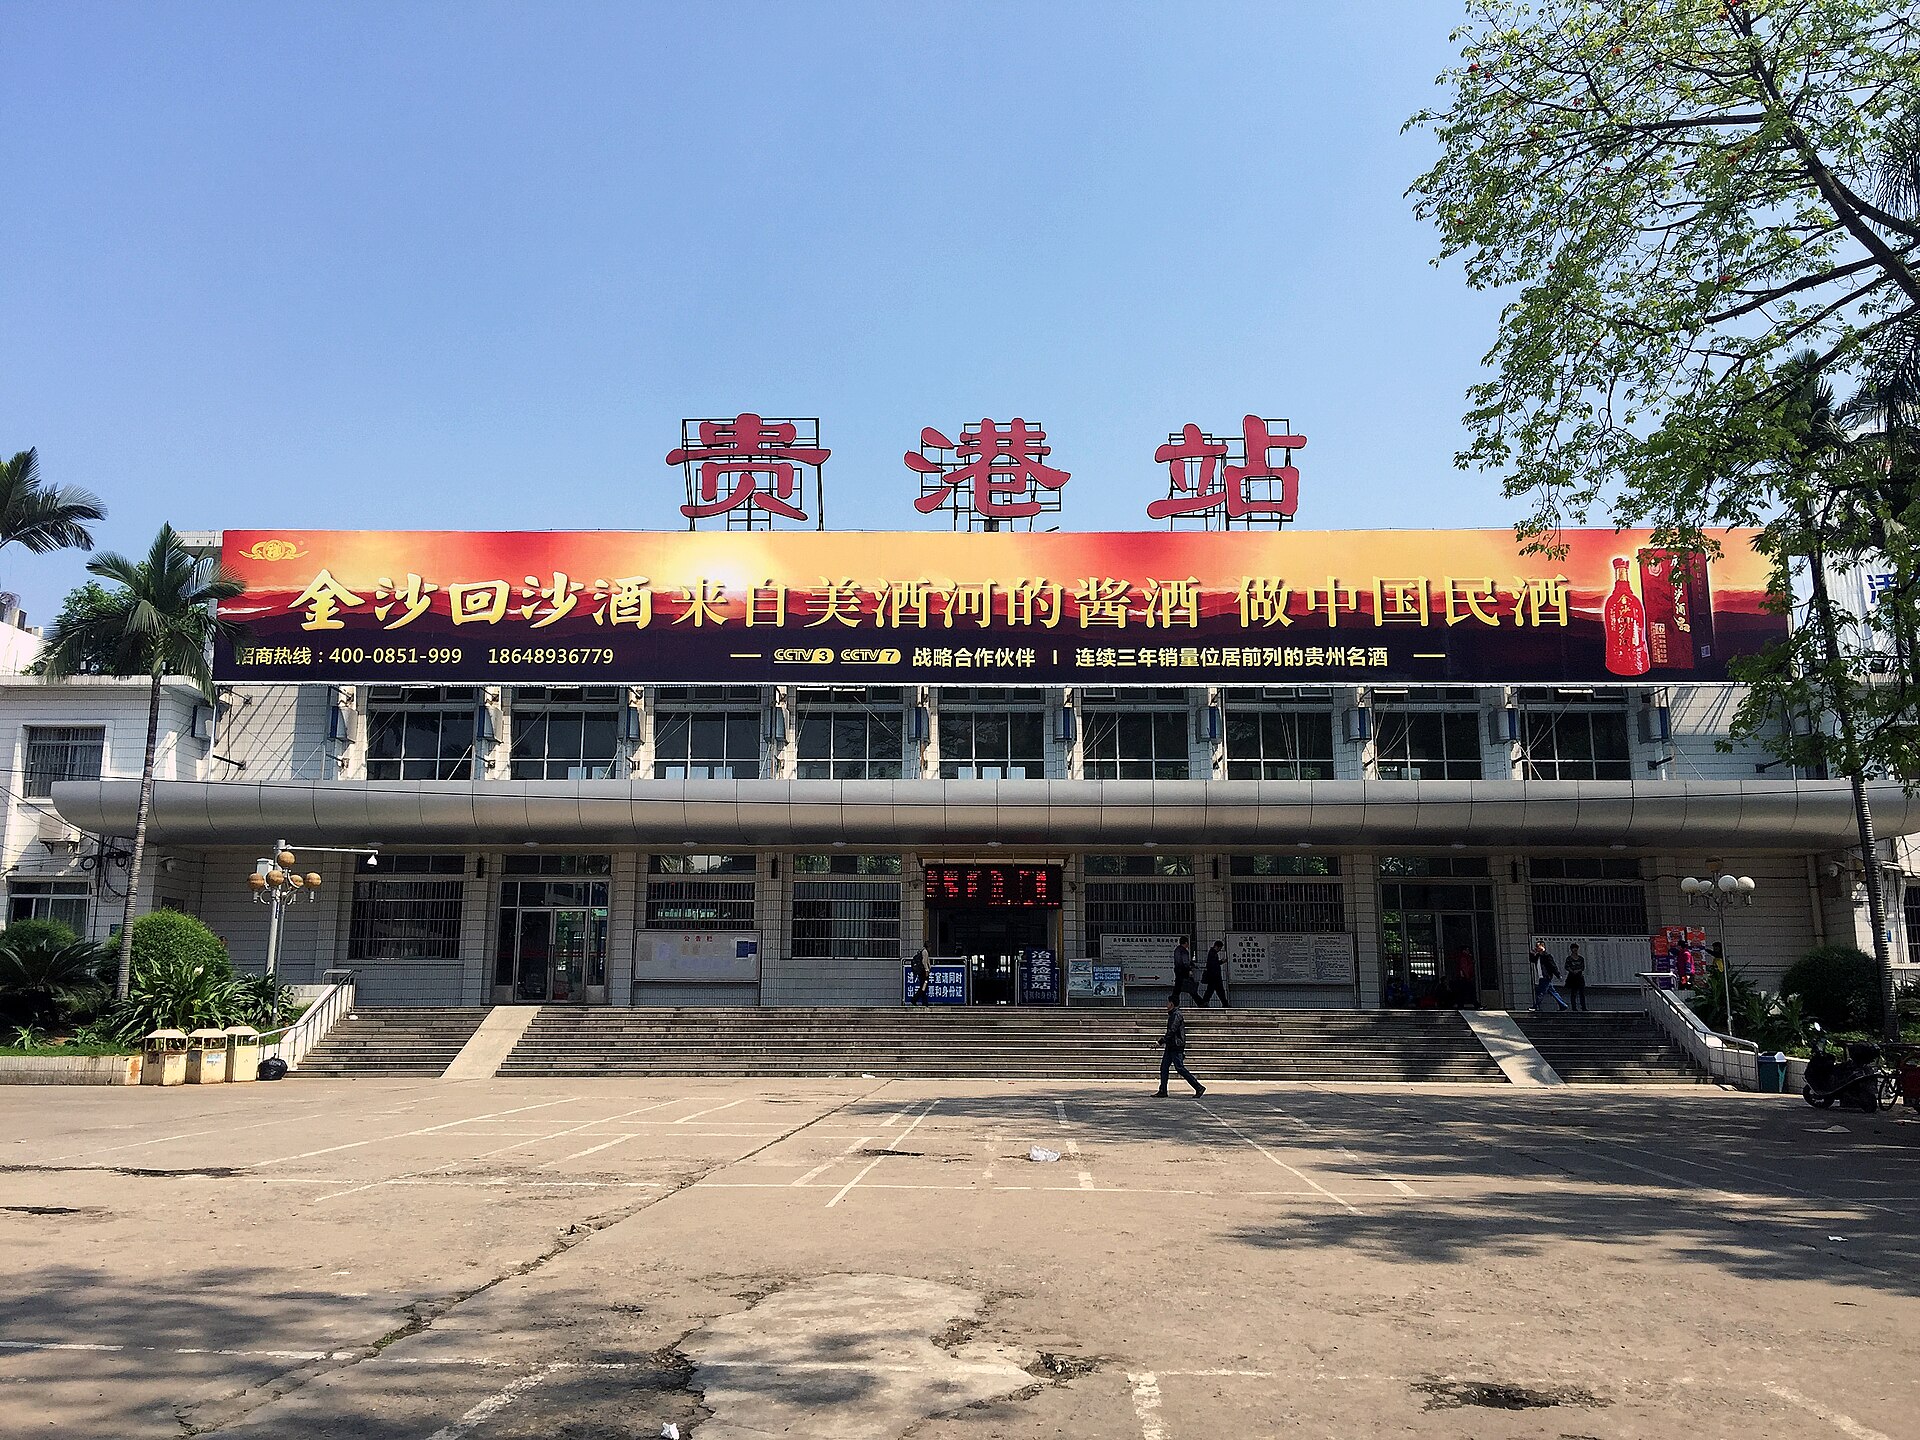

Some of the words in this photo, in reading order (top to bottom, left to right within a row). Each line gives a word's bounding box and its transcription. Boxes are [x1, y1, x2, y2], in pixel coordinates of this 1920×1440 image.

[666, 413, 1307, 520] 贵港站
[287, 568, 653, 630] 金沙回沙酒
[671, 575, 1200, 629] 来自美酒河的酱酒
[1233, 574, 1568, 628] 做中国民酒
[488, 647, 614, 664] 18648936779
[912, 647, 1036, 667] 战略合作伙伴
[1075, 647, 1388, 667] 连续三年销量位居前列的贵州名酒
[1031, 950, 1052, 990] 治安检查站
